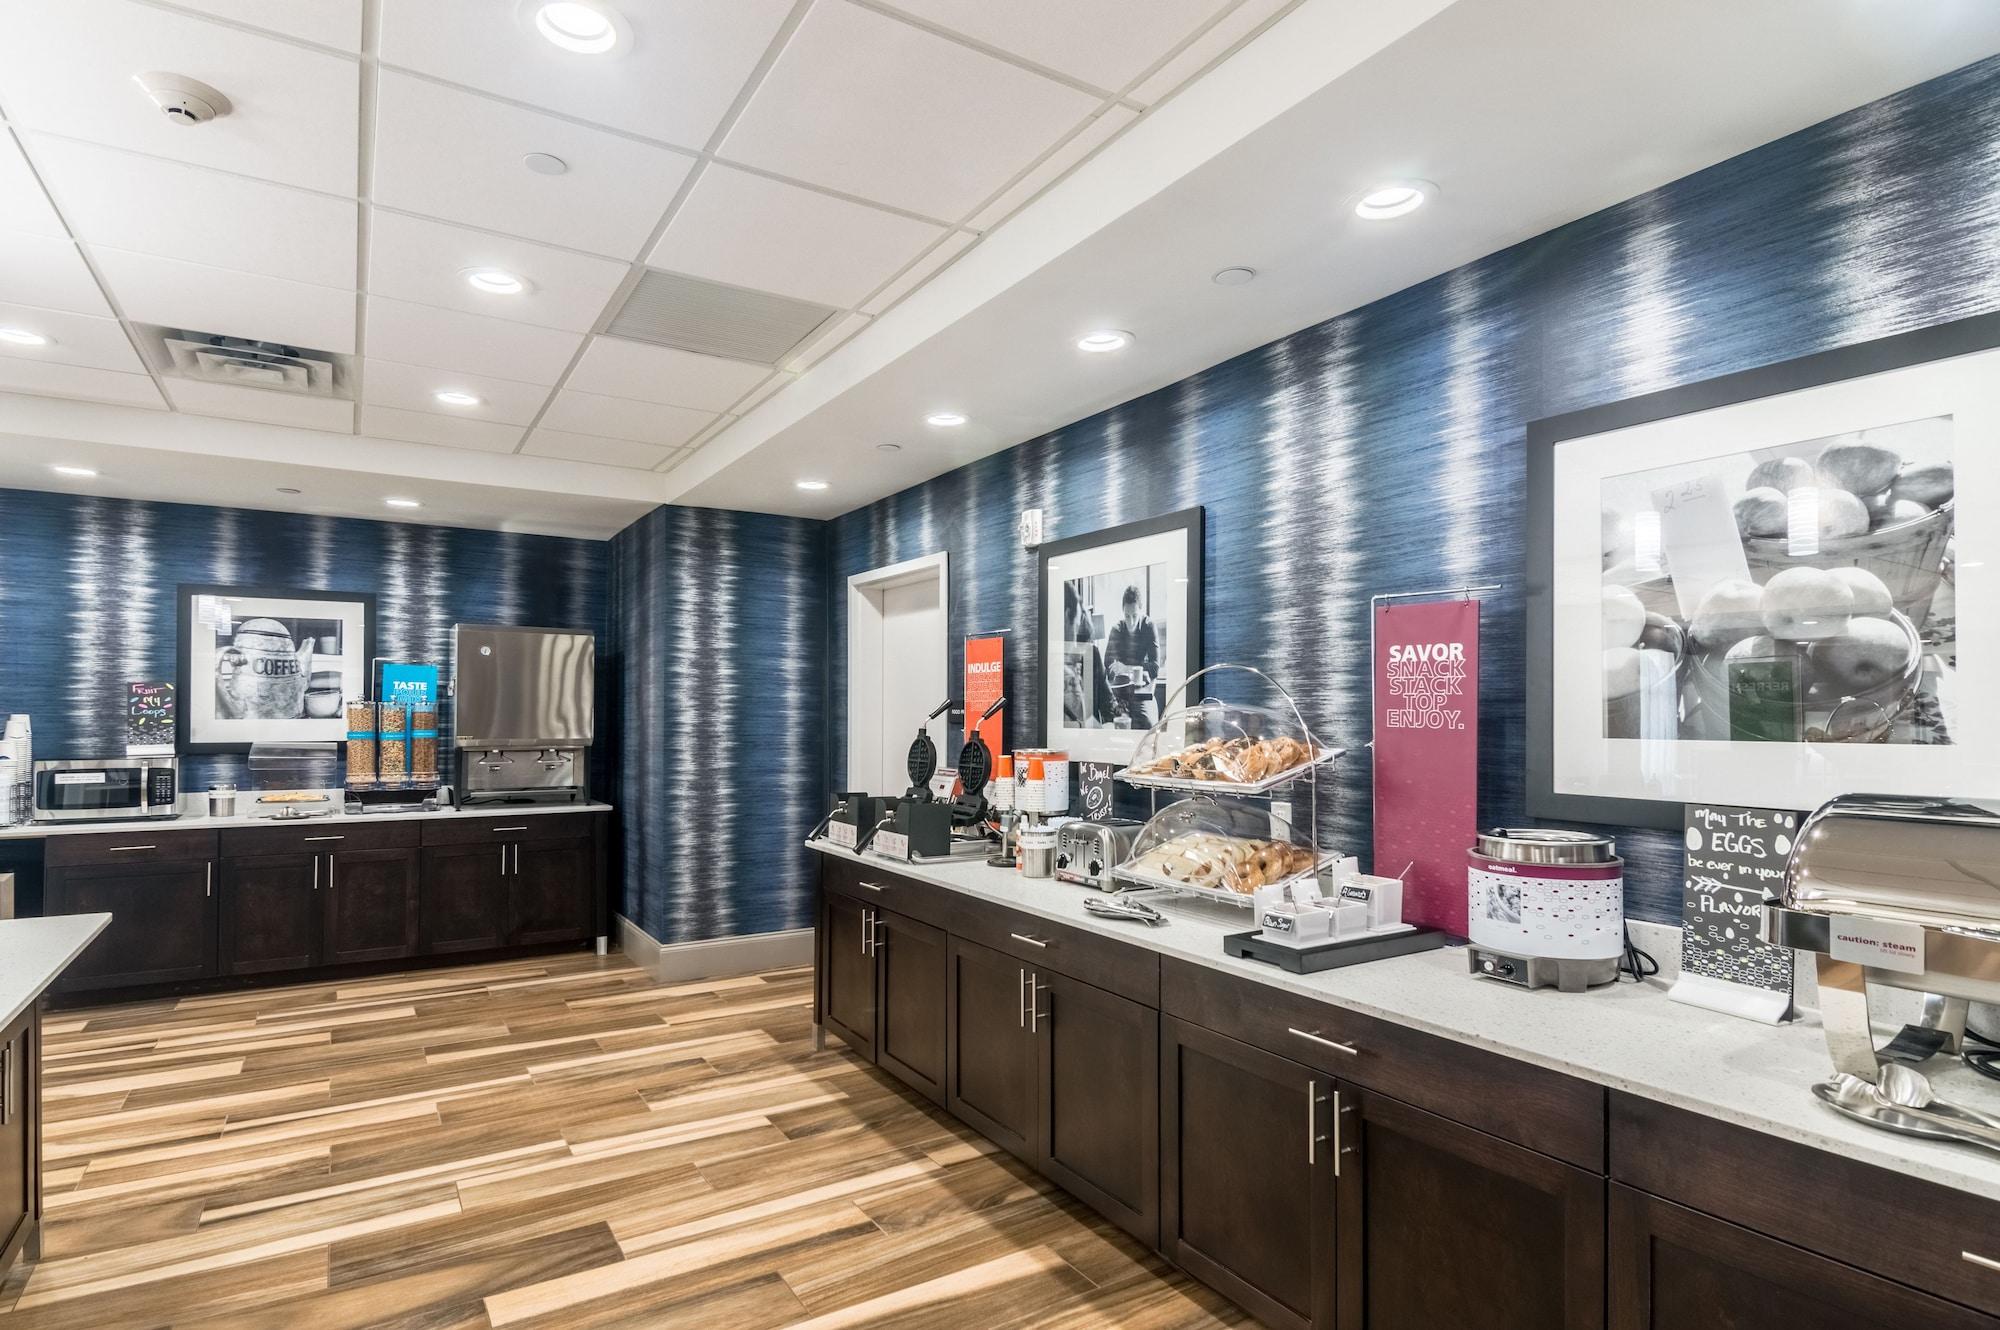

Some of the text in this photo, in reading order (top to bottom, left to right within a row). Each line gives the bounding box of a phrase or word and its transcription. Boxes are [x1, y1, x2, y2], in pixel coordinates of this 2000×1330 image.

[1389, 642, 1465, 662] SAVOR
[967, 661, 1001, 673] INDULGE
[1386, 659, 1467, 678] SNACK
[393, 680, 428, 690] TASTE
[1389, 677, 1464, 695] STACK
[1402, 693, 1448, 712] TOP
[1386, 709, 1465, 729] ENJOY.
[1711, 831, 1768, 859] EGGS
[1687, 853, 1704, 868] be
[1706, 860, 1735, 872] ever
[1882, 941, 1917, 953] steam
